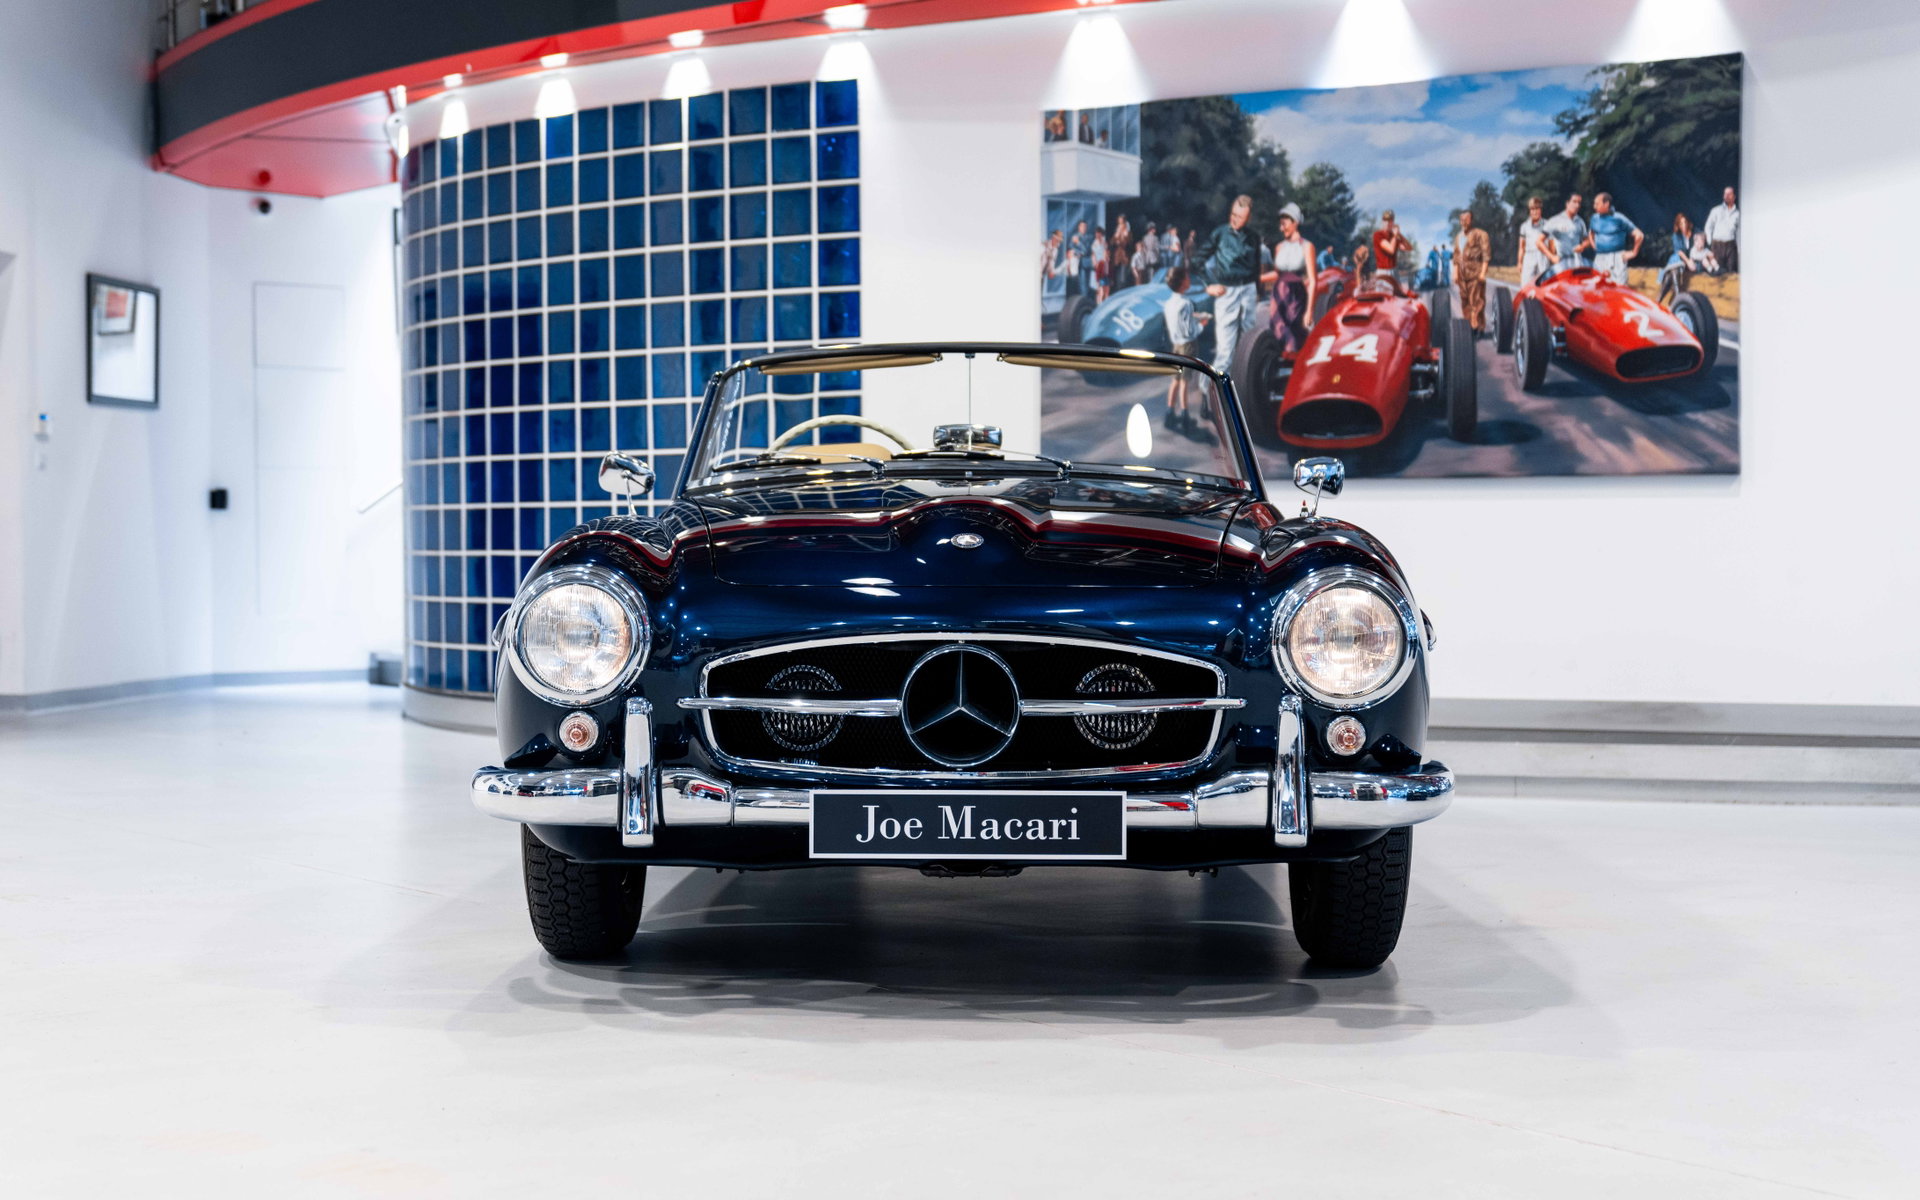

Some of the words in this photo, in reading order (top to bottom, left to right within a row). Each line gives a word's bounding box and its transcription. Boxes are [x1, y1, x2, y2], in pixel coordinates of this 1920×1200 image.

[1112, 308, 1144, 333] 18
[1623, 310, 1665, 337] 2
[1305, 333, 1379, 367] 14
[855, 804, 924, 843] Joe
[937, 805, 1081, 841] Macari
